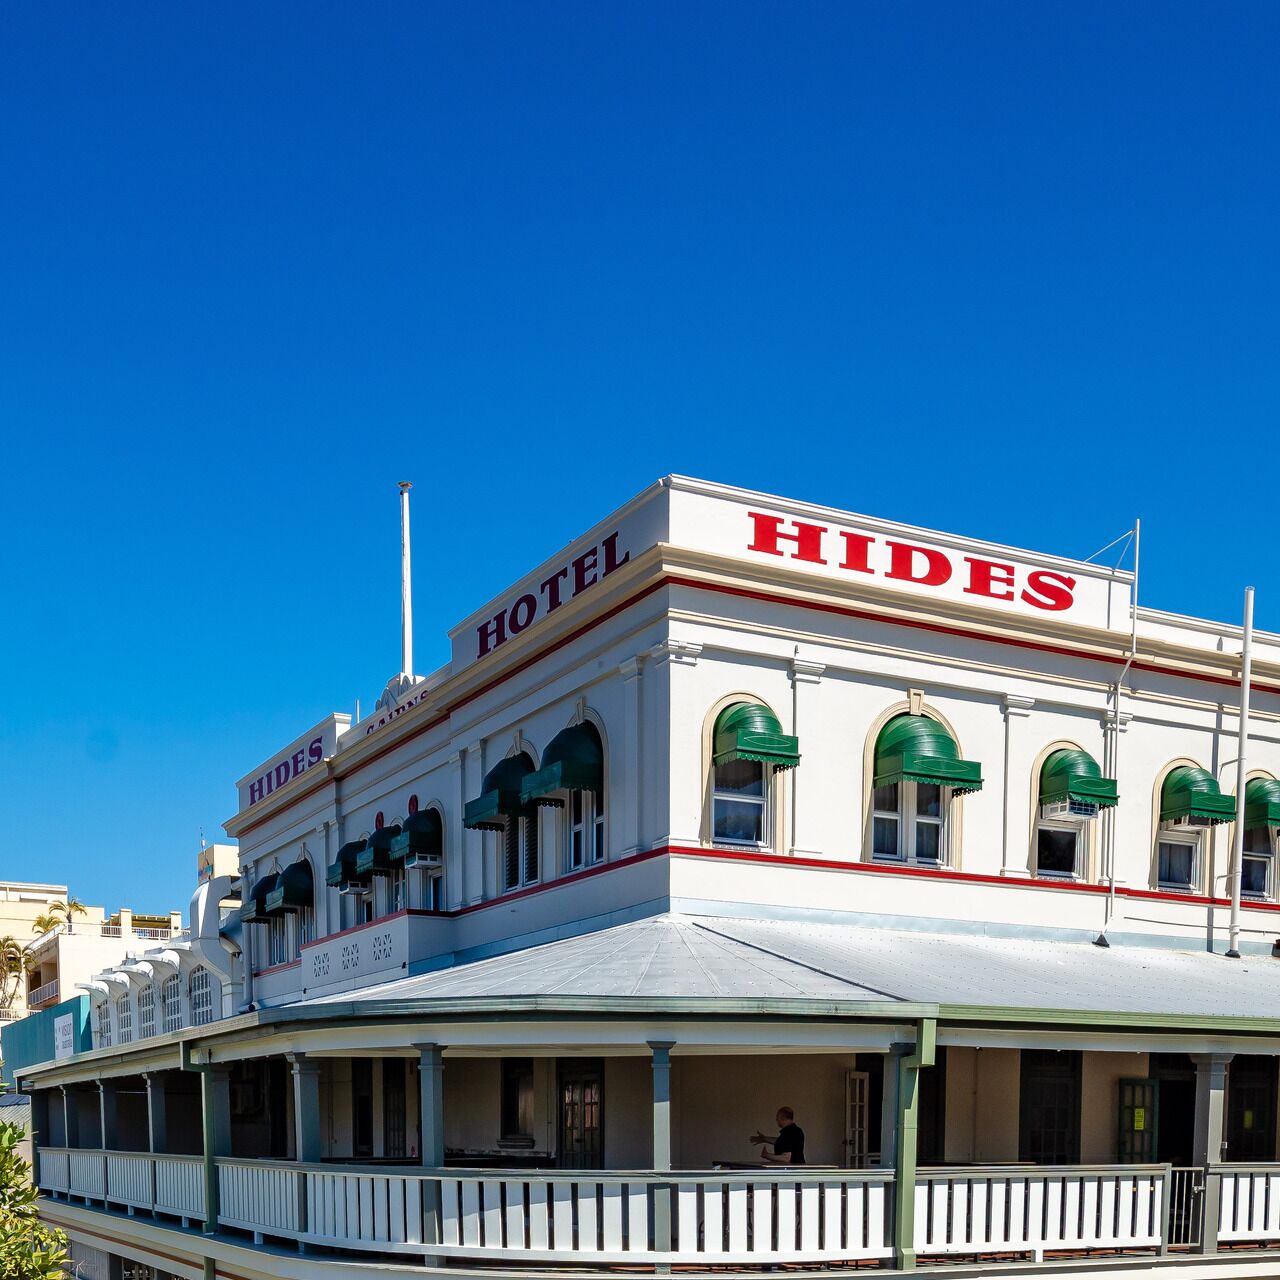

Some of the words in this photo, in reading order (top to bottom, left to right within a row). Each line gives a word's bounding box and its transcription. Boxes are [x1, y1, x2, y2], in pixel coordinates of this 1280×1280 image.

[477, 531, 629, 660] HOTEL
[748, 511, 1076, 611] HIDES
[249, 736, 323, 807] HIDES
